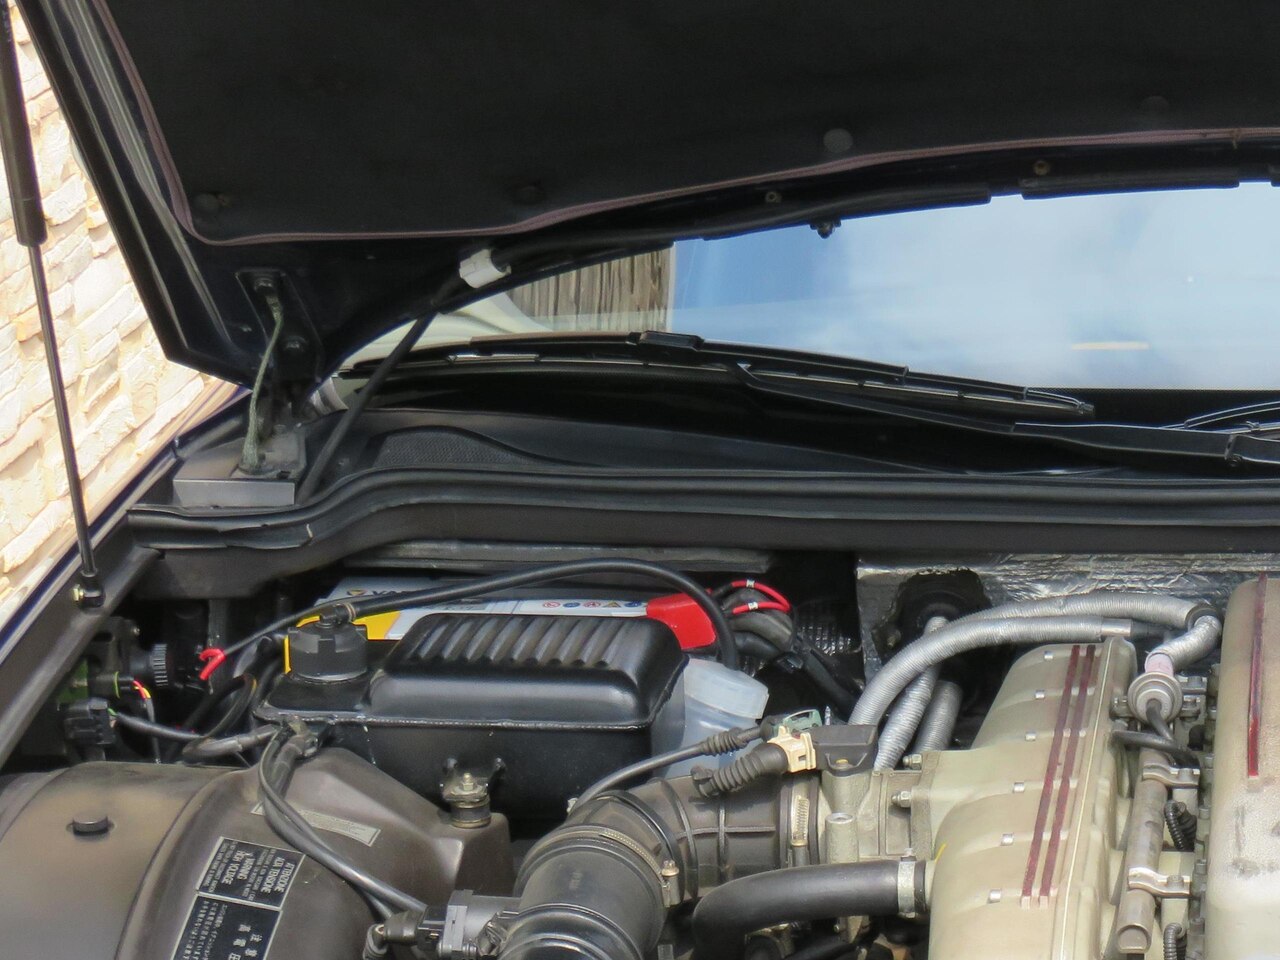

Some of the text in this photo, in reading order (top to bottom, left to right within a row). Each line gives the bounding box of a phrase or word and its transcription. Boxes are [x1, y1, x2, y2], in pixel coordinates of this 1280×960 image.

[232, 850, 247, 862] HIGH
[221, 863, 240, 885] VOLTAGE
[236, 858, 256, 880] WARNING
[273, 862, 296, 893] ATTENZIONE
